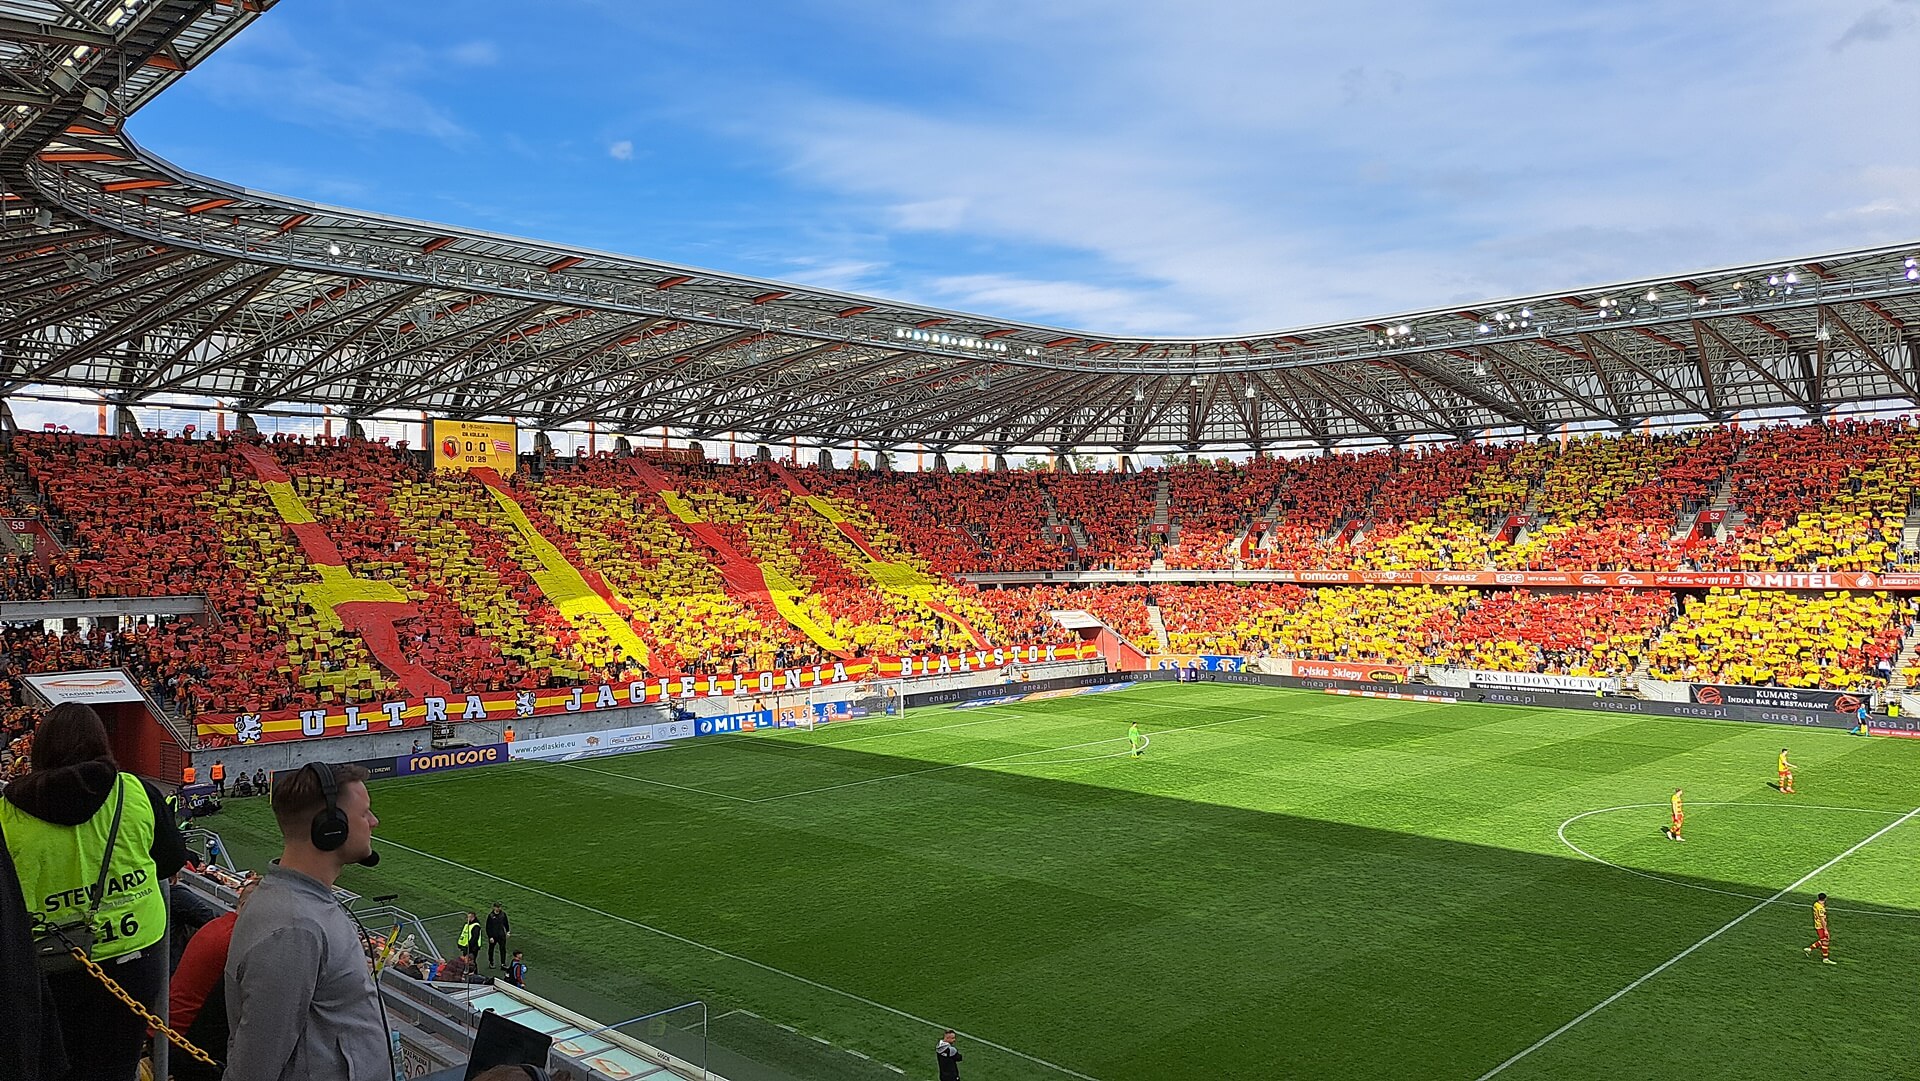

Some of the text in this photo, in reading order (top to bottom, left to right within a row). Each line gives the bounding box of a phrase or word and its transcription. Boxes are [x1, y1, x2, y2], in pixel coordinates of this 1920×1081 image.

[1710, 512, 1720, 520] 52
[11, 521, 25, 530] 59
[1300, 572, 1349, 581] romicore
[1764, 574, 1840, 588] MITEL
[1158, 658, 1179, 671] STS
[1216, 659, 1237, 672] STS
[1120, 672, 1152, 681] enea.pl
[1228, 675, 1261, 683] enea.pl
[1332, 667, 1363, 681] Sklepy
[1080, 676, 1107, 685] enea.pl
[1301, 680, 1338, 689] enea.pl
[1484, 673, 1608, 689] RS BUDOWNICTWO
[300, 645, 1057, 736] ULTRA JAGIELLONIA BIAŁYSTOK
[977, 687, 1007, 697] enea.pl
[1023, 682, 1051, 691] enea.pl
[1360, 684, 1399, 693] enea.pl
[929, 693, 960, 703] enea.pl
[1422, 688, 1465, 699] enea.pl
[1491, 693, 1537, 704] enea.pl
[1756, 690, 1798, 700] KUMAR'S
[1592, 700, 1642, 711] enea.pl
[1756, 698, 1771, 706] BAR
[1779, 700, 1829, 710] RESTAURANT
[1674, 705, 1728, 718] enea.pl
[715, 713, 768, 732] MITEL
[1762, 711, 1821, 724] enea.pl
[1867, 720, 1920, 731] nea.pl
[515, 741, 576, 754] www.podlaskie.eu
[409, 747, 498, 771] romicore
